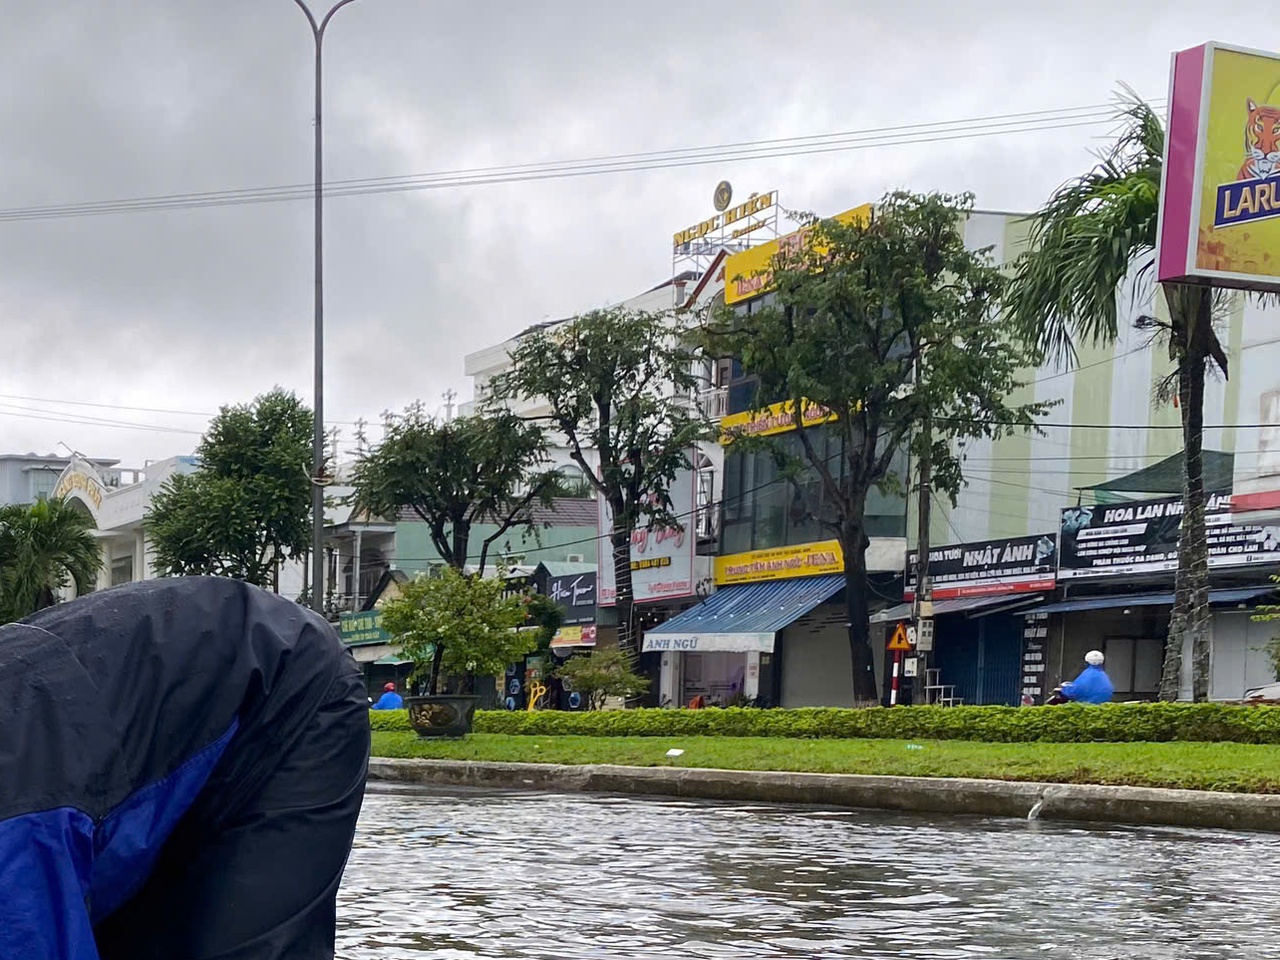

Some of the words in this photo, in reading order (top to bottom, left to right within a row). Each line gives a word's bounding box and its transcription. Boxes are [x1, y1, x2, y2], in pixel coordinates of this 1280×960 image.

[1103, 508, 1139, 523] HOA
[1136, 504, 1164, 520] LAN
[963, 545, 1001, 569] NHẬT
[1001, 542, 1034, 563] ÁNH
[646, 639, 670, 649] ANH
